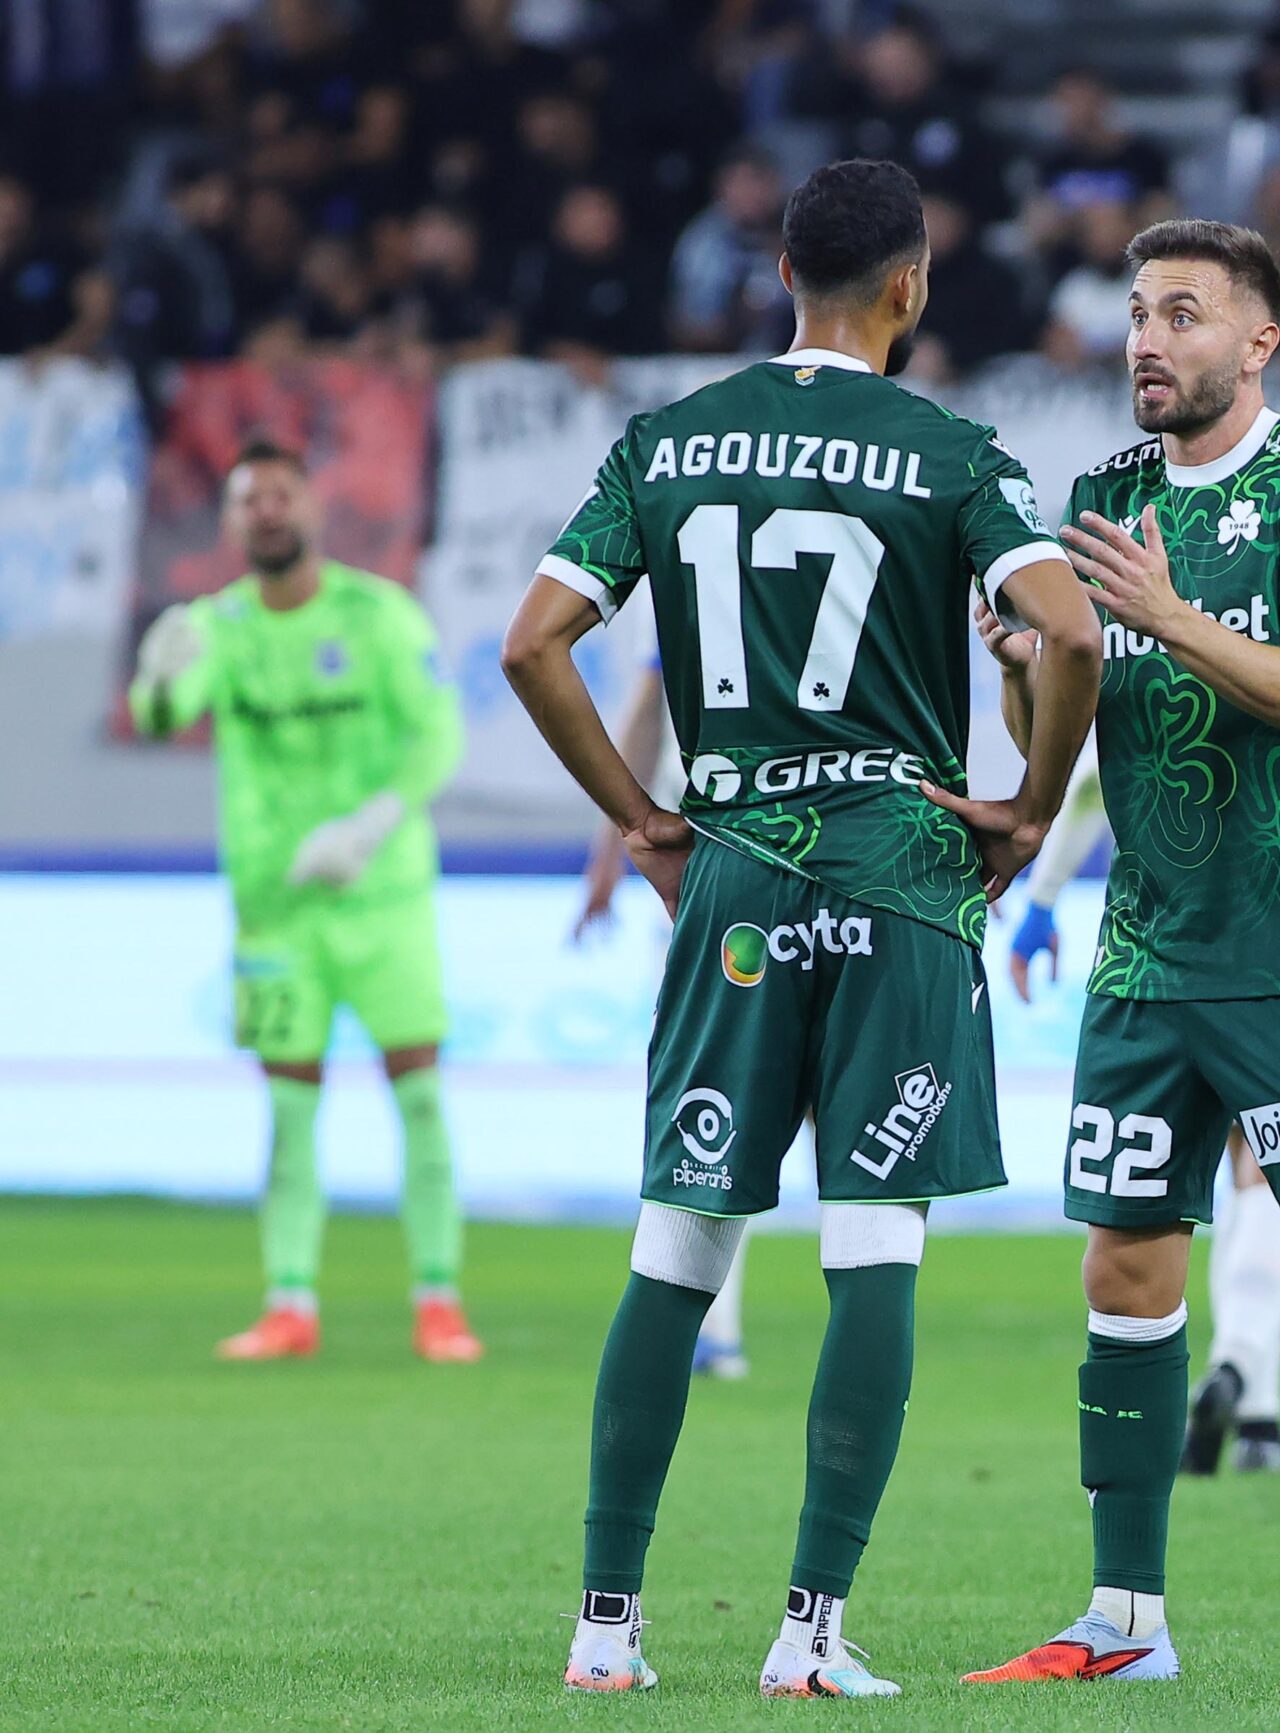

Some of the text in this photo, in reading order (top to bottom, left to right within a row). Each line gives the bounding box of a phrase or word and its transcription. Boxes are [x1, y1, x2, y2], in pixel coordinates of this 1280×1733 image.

[644, 432, 932, 499] AGOUZOUL
[1229, 522, 1250, 530] 1948
[677, 504, 885, 711] 17
[1103, 594, 1270, 660] noet
[754, 748, 926, 794] GREE
[768, 908, 873, 971] cyta
[850, 1073, 936, 1181] Line
[904, 1081, 952, 1162] promotions
[1070, 1103, 1172, 1198] 22
[672, 1159, 733, 1191] piperaris
